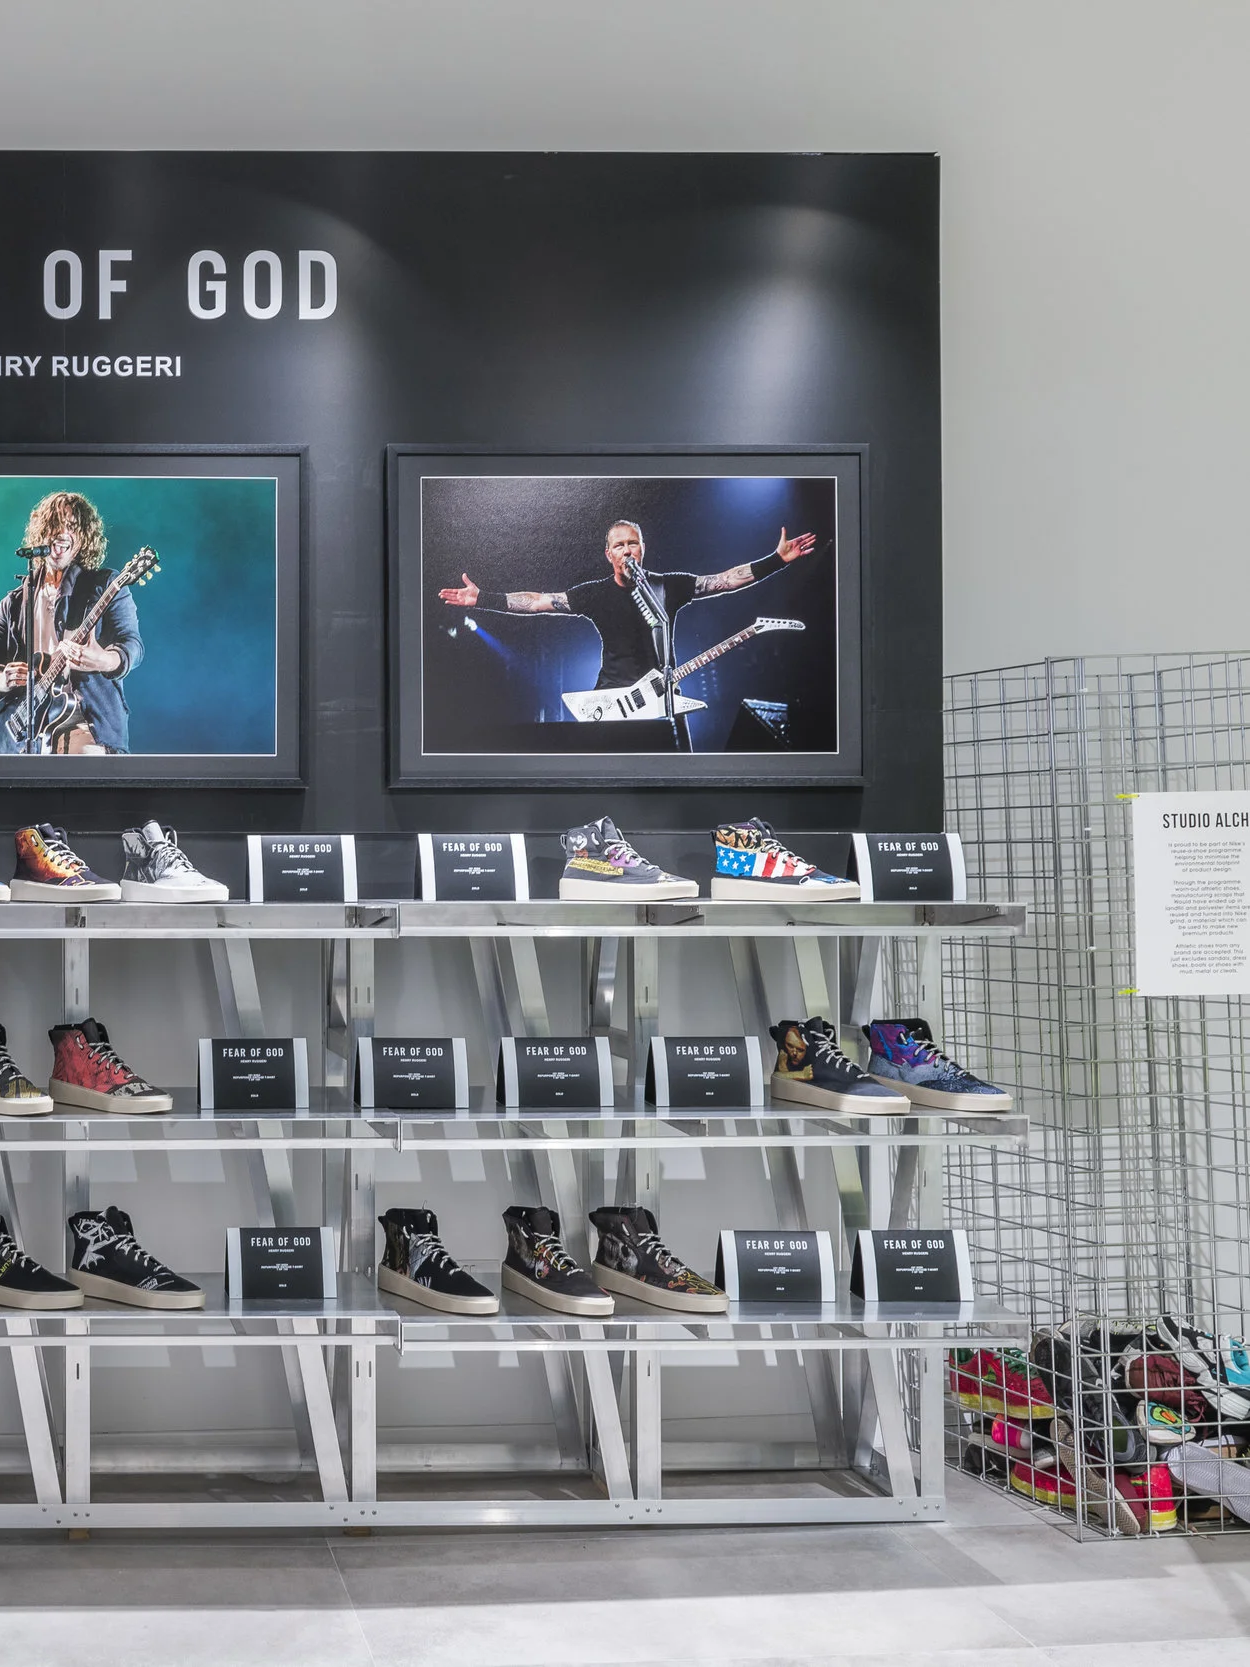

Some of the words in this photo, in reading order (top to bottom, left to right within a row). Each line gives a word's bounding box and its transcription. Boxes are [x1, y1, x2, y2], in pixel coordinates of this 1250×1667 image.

[43, 249, 133, 320] OF
[187, 249, 338, 320] GOD
[51, 355, 181, 377] RUGGERI
[1162, 813, 1210, 829] STUDIO
[1215, 812, 1249, 828] ALCH
[271, 843, 295, 853] FEAR
[298, 843, 310, 853] OF
[314, 843, 332, 853] GOD
[442, 842, 466, 852] FEAR
[469, 842, 481, 852] OF
[484, 842, 503, 852] GOD
[877, 841, 902, 852] FEAR
[904, 841, 917, 852] OF
[920, 841, 939, 852] GOD
[222, 1047, 246, 1058] FEAR
[250, 1047, 262, 1058] OF
[265, 1047, 284, 1057] GOD
[382, 1046, 406, 1057] FEAR
[409, 1047, 421, 1057] OF
[425, 1047, 444, 1057] GOD
[525, 1046, 550, 1056] FEAR
[553, 1046, 565, 1056] OF
[568, 1046, 587, 1056] GOD
[675, 1045, 700, 1056] FEAR
[703, 1045, 715, 1056] OF
[718, 1045, 737, 1056] GOD
[250, 1237, 274, 1247] FEAR
[277, 1236, 289, 1247] OF
[293, 1236, 311, 1247] GOD
[745, 1240, 770, 1250] FEAR
[773, 1240, 785, 1250] OF
[789, 1240, 808, 1250] GOD
[883, 1239, 908, 1250] FEAR
[910, 1239, 922, 1250] OF
[926, 1239, 945, 1250] GOD
